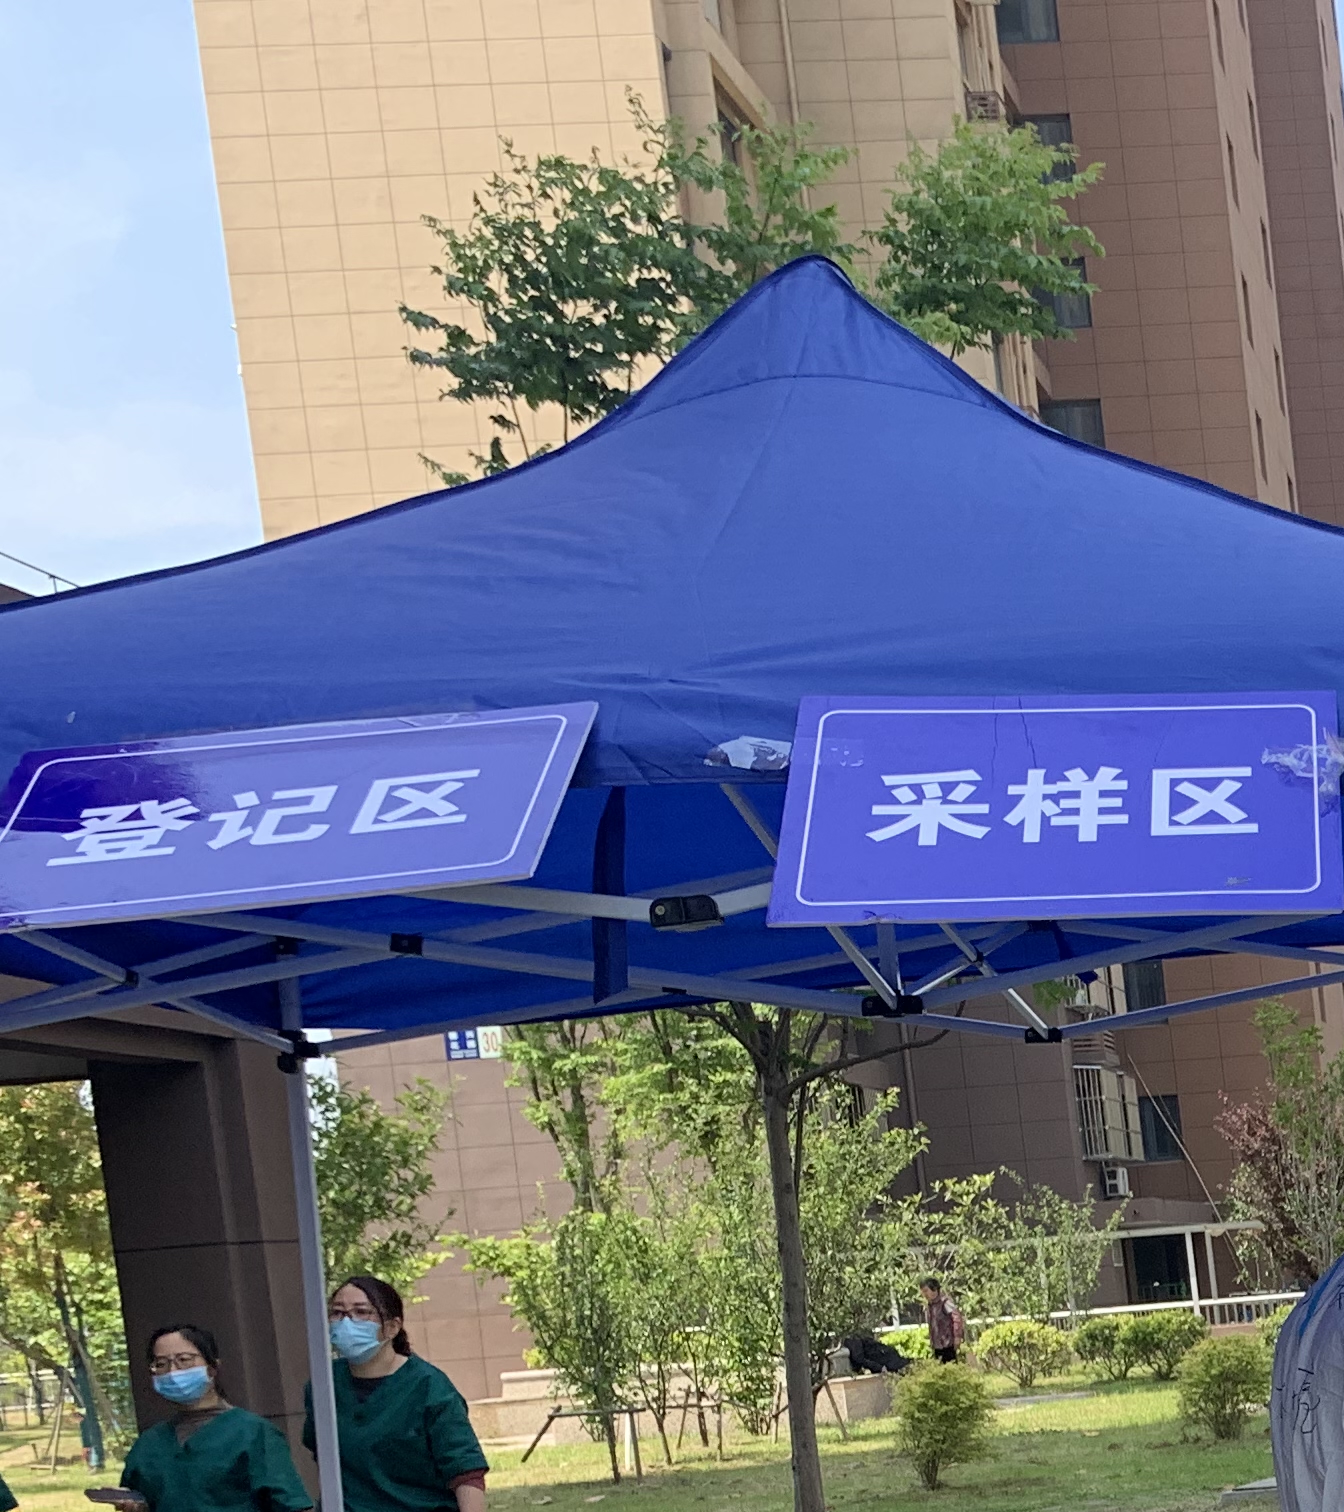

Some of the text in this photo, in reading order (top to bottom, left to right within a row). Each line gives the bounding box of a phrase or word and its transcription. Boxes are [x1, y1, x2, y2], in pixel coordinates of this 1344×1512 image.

[46, 768, 482, 867] 登记区
[865, 766, 1260, 846] 采样区
